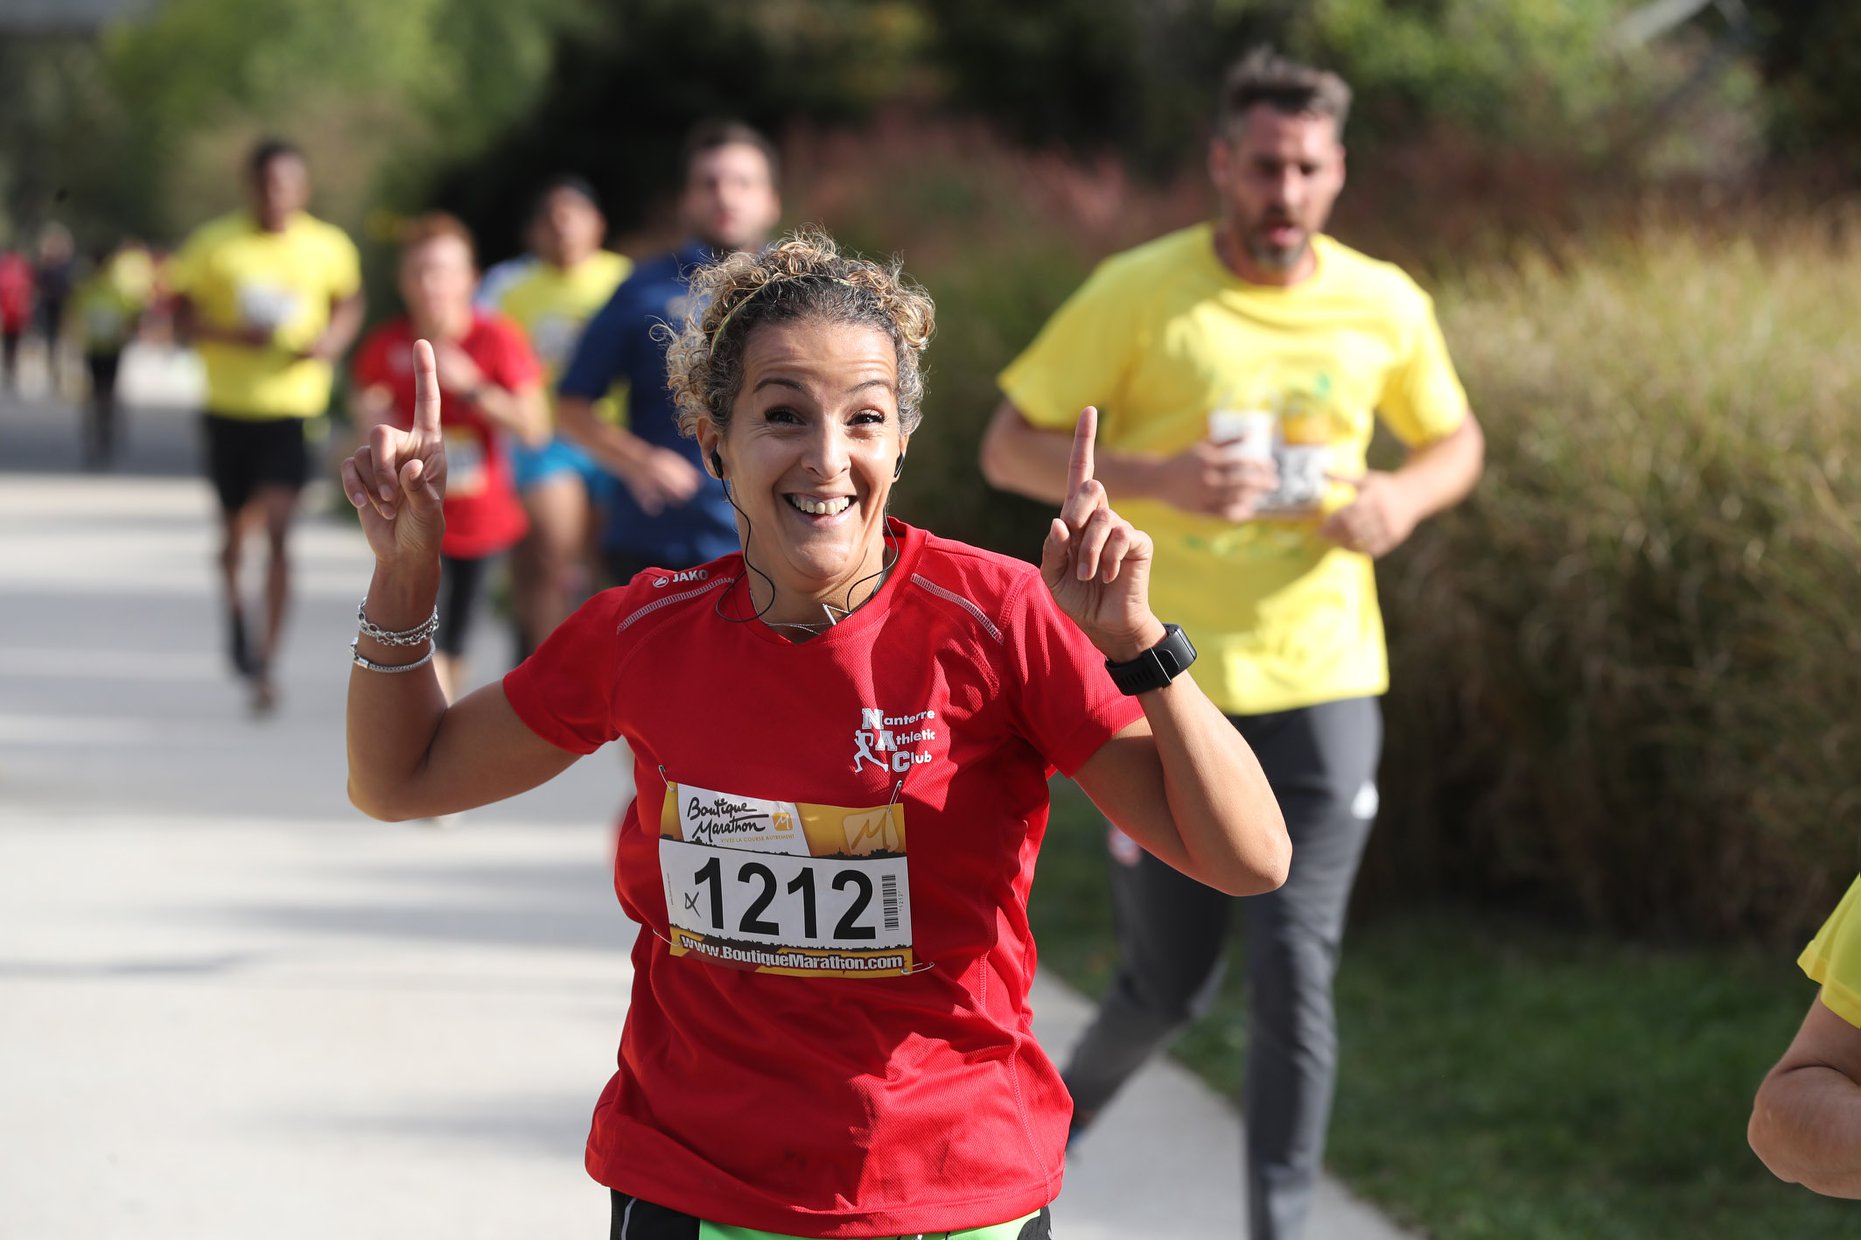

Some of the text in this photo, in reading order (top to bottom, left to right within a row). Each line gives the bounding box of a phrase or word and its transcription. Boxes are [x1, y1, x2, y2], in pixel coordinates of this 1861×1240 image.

[673, 569, 708, 583] JAKO
[862, 708, 935, 729] Nanterre
[875, 729, 936, 751] Athletic
[892, 750, 932, 772] Club
[687, 796, 757, 820] Boutique
[691, 813, 769, 842] Marathon
[694, 856, 876, 940] 1212
[680, 935, 903, 971] www.BoutiqueMarathon.com
